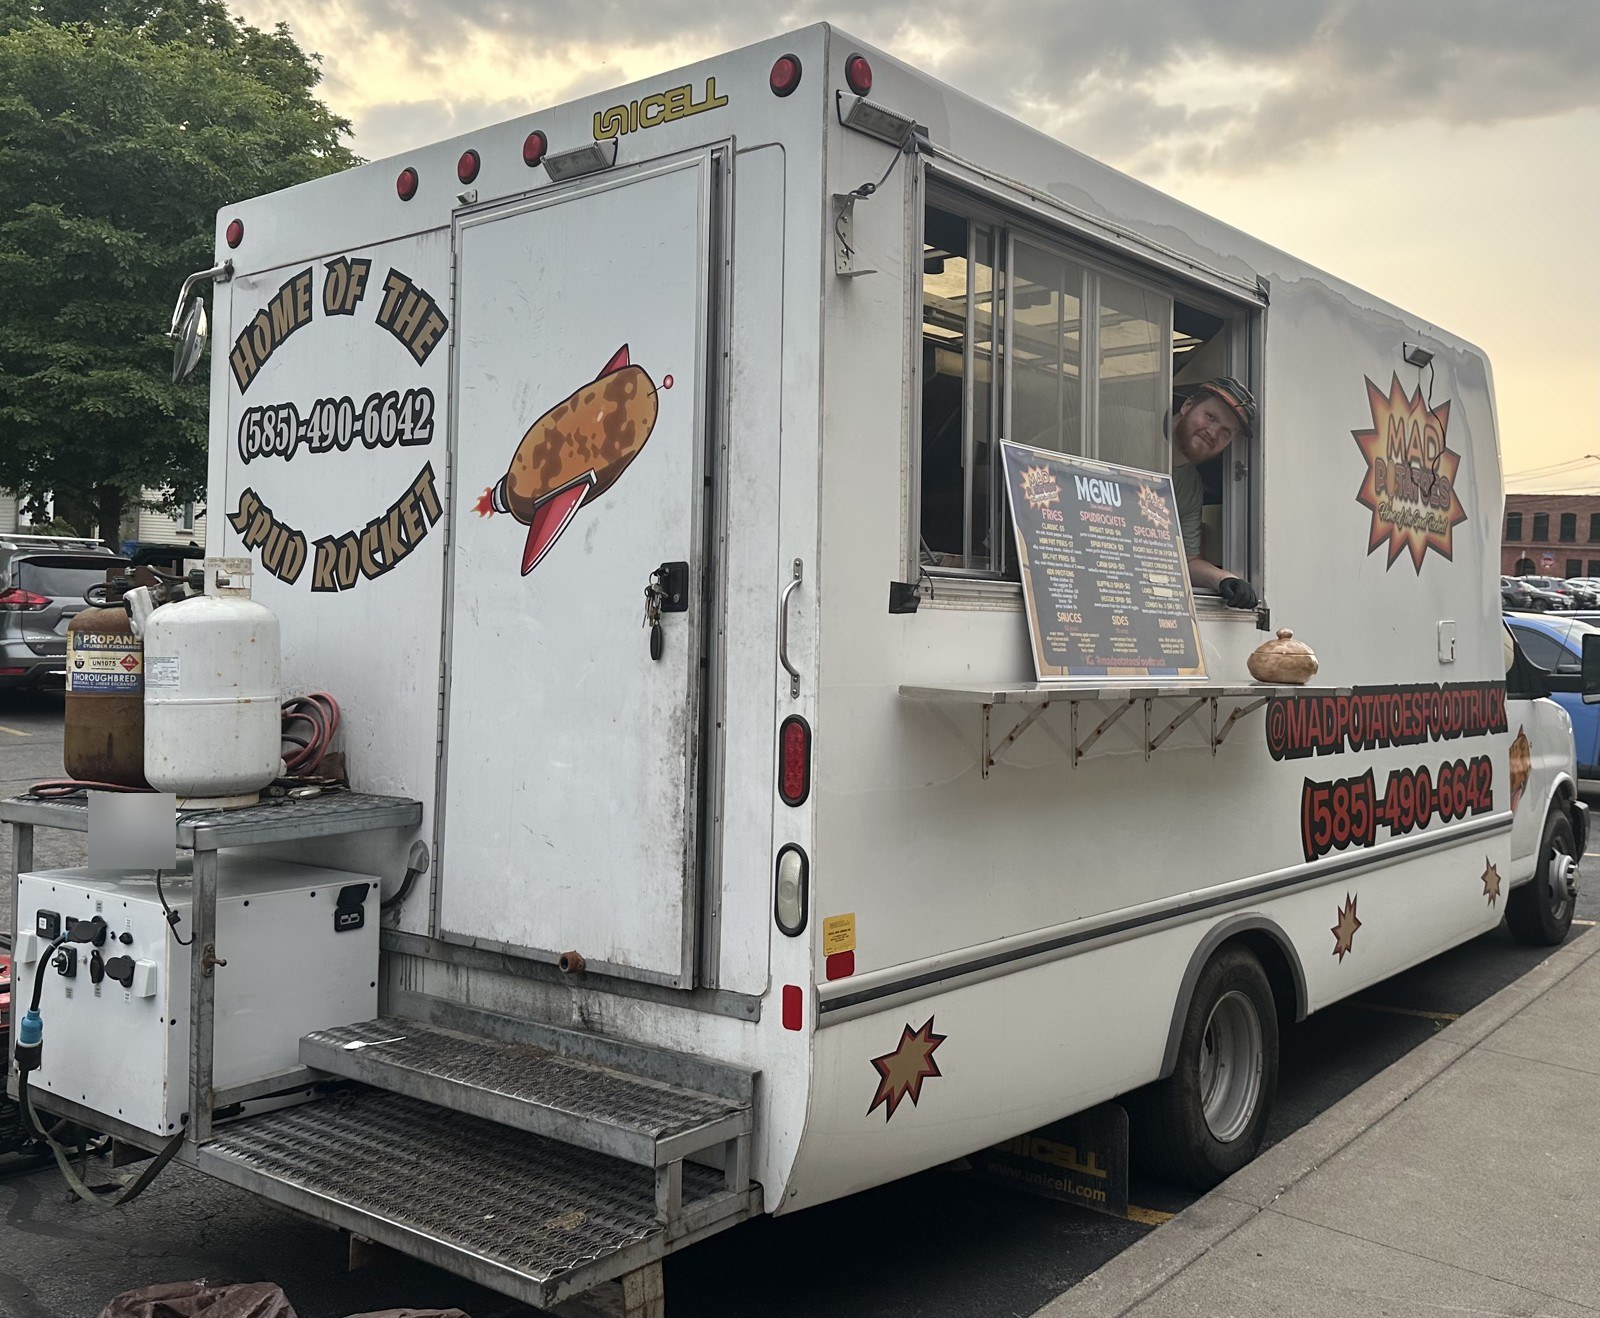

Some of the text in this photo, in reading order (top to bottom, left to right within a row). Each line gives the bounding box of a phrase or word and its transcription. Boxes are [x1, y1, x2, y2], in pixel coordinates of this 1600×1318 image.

[593, 76, 729, 141] UNICELL
[229, 255, 449, 395] HOME OF THE
[238, 387, 435, 465] (585)-490-6642
[1386, 413, 1441, 472] MAD
[1074, 475, 1122, 507] MENU
[226, 460, 443, 592] SPUD ROCKET
[1042, 508, 1063, 521] FRIES
[1080, 511, 1126, 527] SPUDROCKETS
[1133, 525, 1170, 540] SPECIALTIES
[1057, 612, 1082, 623] SAUCES
[1111, 615, 1129, 626] SIDES
[83, 634, 142, 645] PROPANE
[73, 673, 137, 683] THOROUGHBRED
[1266, 680, 1508, 761] @MADPOTATOESFOODTRUCK
[1301, 755, 1493, 863] (585)-490-6642
